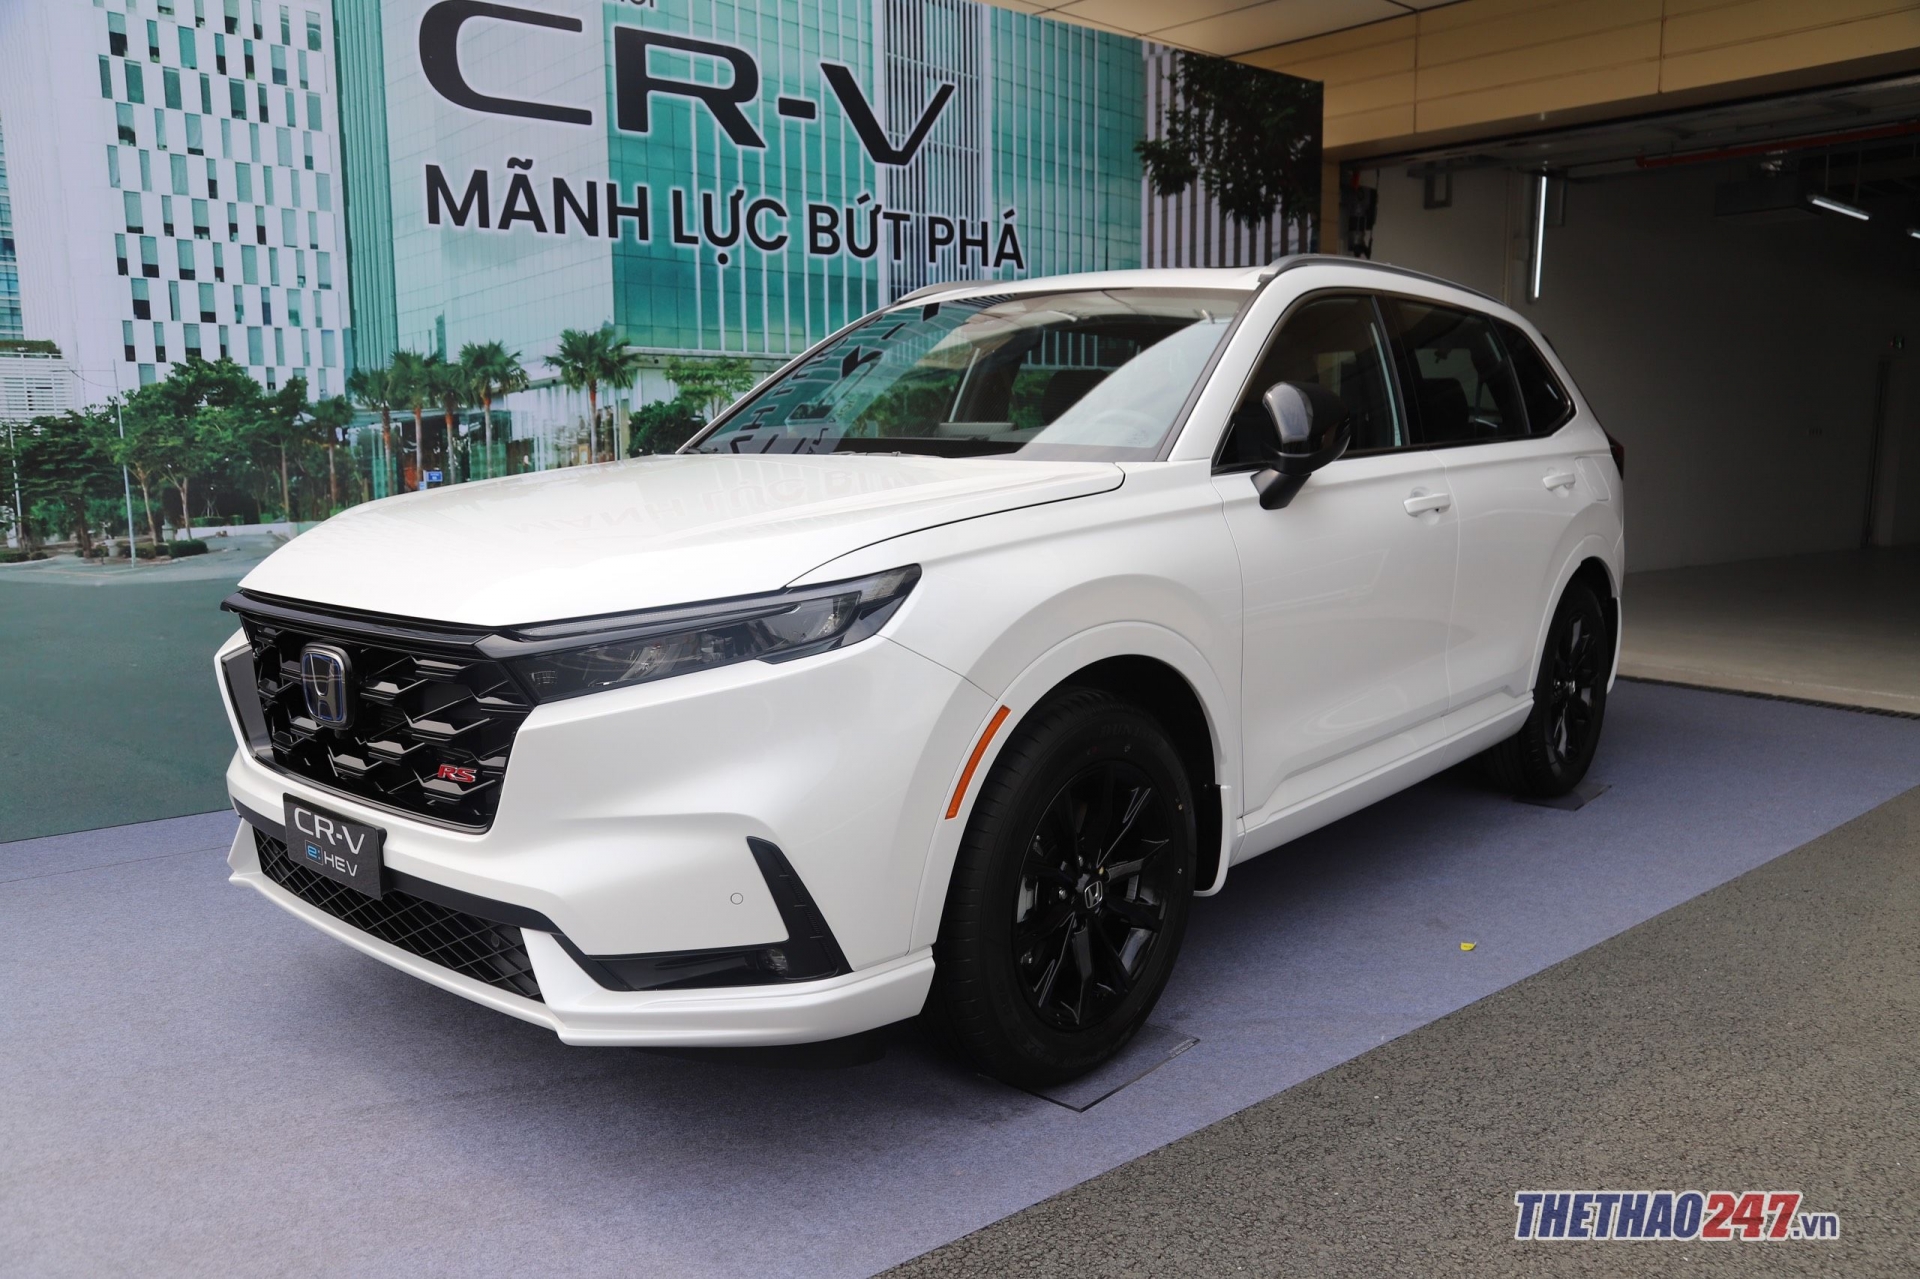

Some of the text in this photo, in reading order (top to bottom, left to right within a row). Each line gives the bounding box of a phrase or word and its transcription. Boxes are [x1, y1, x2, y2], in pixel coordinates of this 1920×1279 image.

[418, 0, 955, 166] CR-V
[425, 158, 1024, 270] MÃNH LỰC BỨT PHÁ
[437, 764, 477, 783] RS
[294, 807, 365, 855] CR-V
